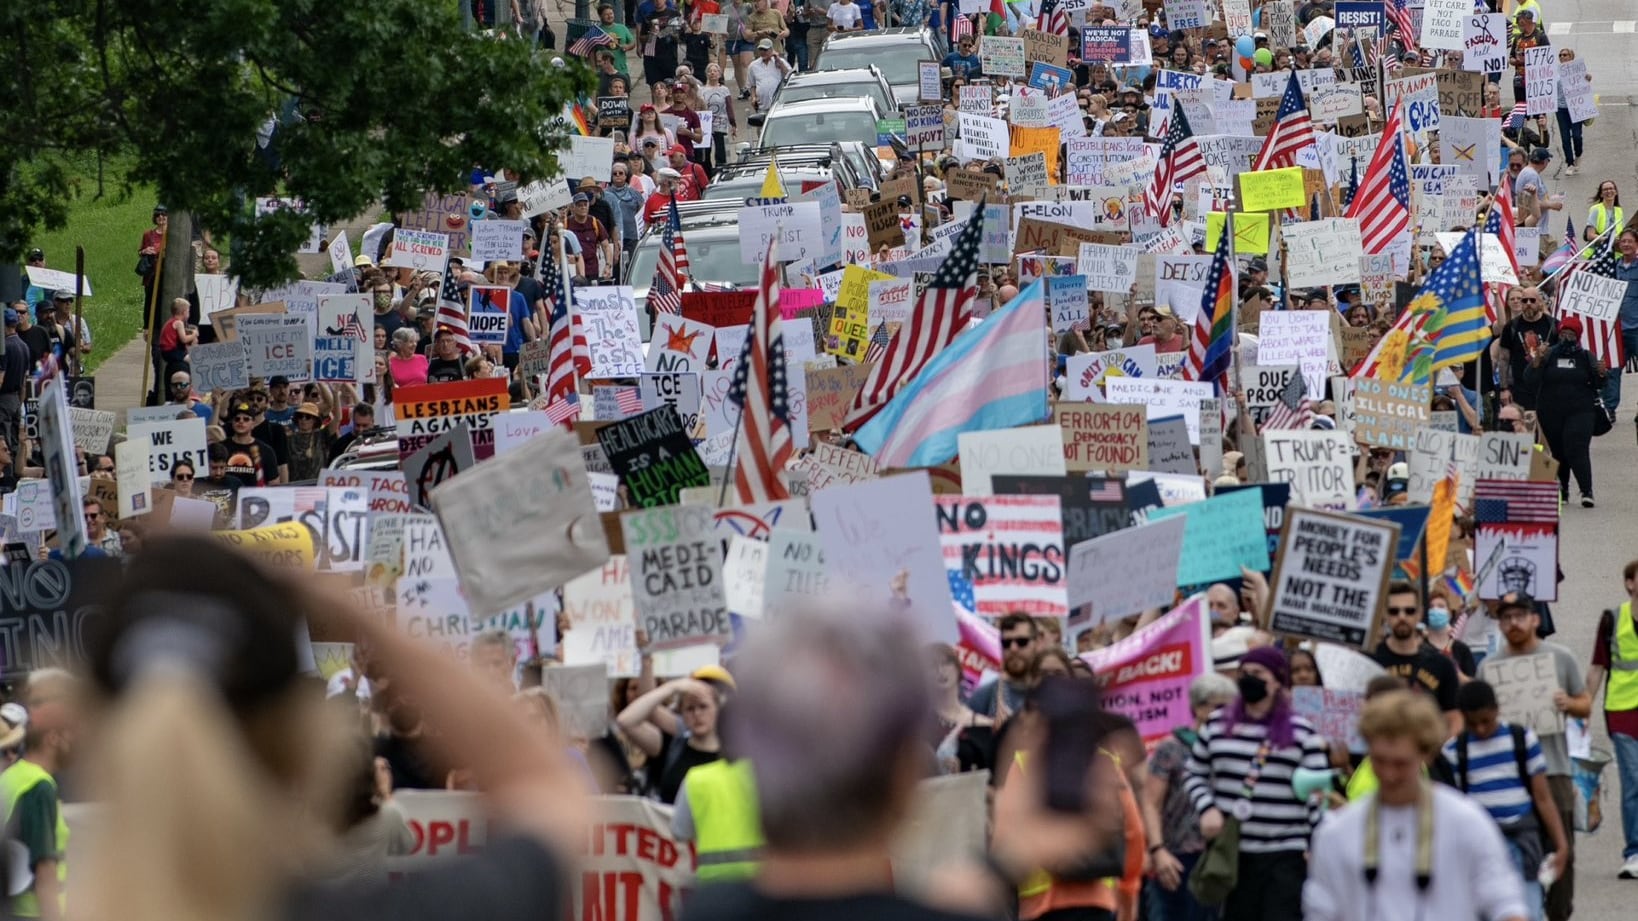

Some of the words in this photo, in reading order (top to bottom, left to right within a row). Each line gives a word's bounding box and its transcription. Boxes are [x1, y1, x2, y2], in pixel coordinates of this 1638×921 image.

[1273, 2, 1287, 13] NO
[1429, 0, 1443, 8] VET
[1445, 1, 1466, 10] CARE
[1339, 11, 1381, 24] RESIST!
[1431, 18, 1451, 27] TACO
[1437, 10, 1453, 18] NOT
[1174, 17, 1199, 29] FREE
[1022, 29, 1062, 48] ABOLISH
[1430, 29, 1460, 38] PARADE
[1033, 42, 1051, 54] ICE
[1526, 47, 1555, 66] 1776
[1029, 51, 1056, 63] NOW
[1484, 56, 1505, 72] NO!
[1156, 70, 1202, 90] LIBERTY
[1385, 75, 1436, 97] TYRANNY
[1527, 79, 1553, 98] 2025
[602, 100, 627, 110] DOWN
[907, 108, 920, 118] NO
[920, 105, 942, 117] GODS
[907, 118, 920, 128] NO
[908, 135, 918, 146] IN
[1006, 157, 1017, 167] SO
[1018, 162, 1045, 175] WRONG
[955, 172, 967, 180] NO
[1411, 167, 1428, 180] YOU
[952, 180, 974, 188] SINCE
[1069, 189, 1091, 201] WE
[760, 206, 794, 218] TRUMP
[868, 203, 894, 220] FIGHT
[1021, 204, 1073, 217] F-ELON
[394, 241, 408, 253] ALL
[411, 242, 442, 256] SCREWED
[1361, 256, 1391, 273] USA
[1573, 272, 1593, 292] NO
[1593, 278, 1624, 301] KINGS
[577, 287, 633, 311] Smash
[469, 315, 505, 331] NOPE
[1056, 310, 1086, 322] ALL
[590, 318, 626, 340] The
[265, 343, 295, 360] ICE
[315, 338, 353, 351] MELT
[1260, 338, 1289, 350] ABOUT
[590, 341, 638, 365] Fash
[1101, 353, 1125, 367] YOU
[196, 359, 248, 391] ICE
[314, 358, 355, 379] ICE
[616, 363, 642, 375] ICE
[652, 374, 682, 397] ICE
[1259, 370, 1289, 388] DUE
[1247, 388, 1285, 403] PROC
[1357, 380, 1382, 395] NO
[1387, 384, 1430, 404] ONES
[402, 395, 500, 420] LESBIANS
[1356, 396, 1428, 421] ILLEGAL
[151, 430, 174, 446] WE
[597, 406, 683, 457] HEALTHCARE
[1073, 432, 1138, 446] DEMOCRACY
[1365, 430, 1417, 450] LAND
[149, 448, 207, 473] ESIST
[628, 453, 651, 472] IS
[1087, 445, 1141, 466] FOUND!
[625, 449, 708, 499] HUMAN
[935, 501, 988, 534] NO
[1297, 517, 1350, 541] MONEY
[1354, 529, 1382, 547] FOR
[962, 535, 1062, 584] KINGS
[1292, 535, 1379, 567] PEOPLE'S
[1301, 556, 1362, 582] NEEDS
[644, 564, 714, 597] CAID
[1285, 575, 1327, 598] NOT
[1332, 583, 1371, 609] THE
[1280, 597, 1308, 610] WAR
[645, 606, 729, 644] PARADE
[1150, 686, 1183, 704] NOT
